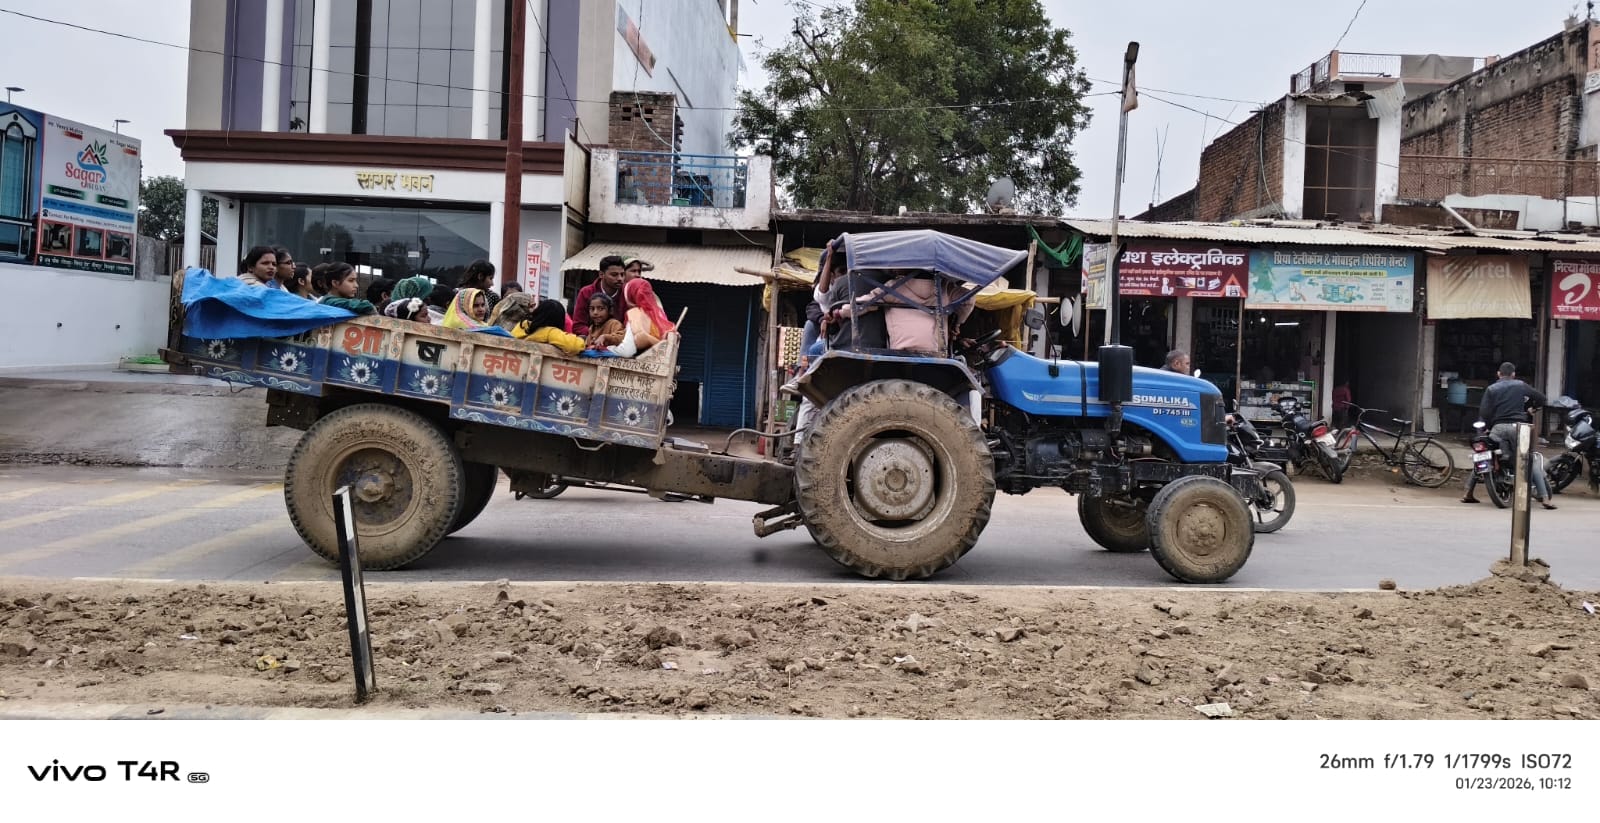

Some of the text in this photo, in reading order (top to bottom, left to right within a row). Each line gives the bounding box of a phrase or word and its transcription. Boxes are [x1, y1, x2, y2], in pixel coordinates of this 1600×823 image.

[65, 161, 102, 188] Sagar
[353, 171, 435, 192] सागर भवन
[1273, 251, 1291, 265] प्रिया
[1324, 253, 1331, 266] &
[1331, 252, 1361, 267] मोबाइल
[1579, 260, 1600, 274] मोबा
[482, 350, 522, 377] कृषि
[1132, 394, 1189, 406] SONALIKA
